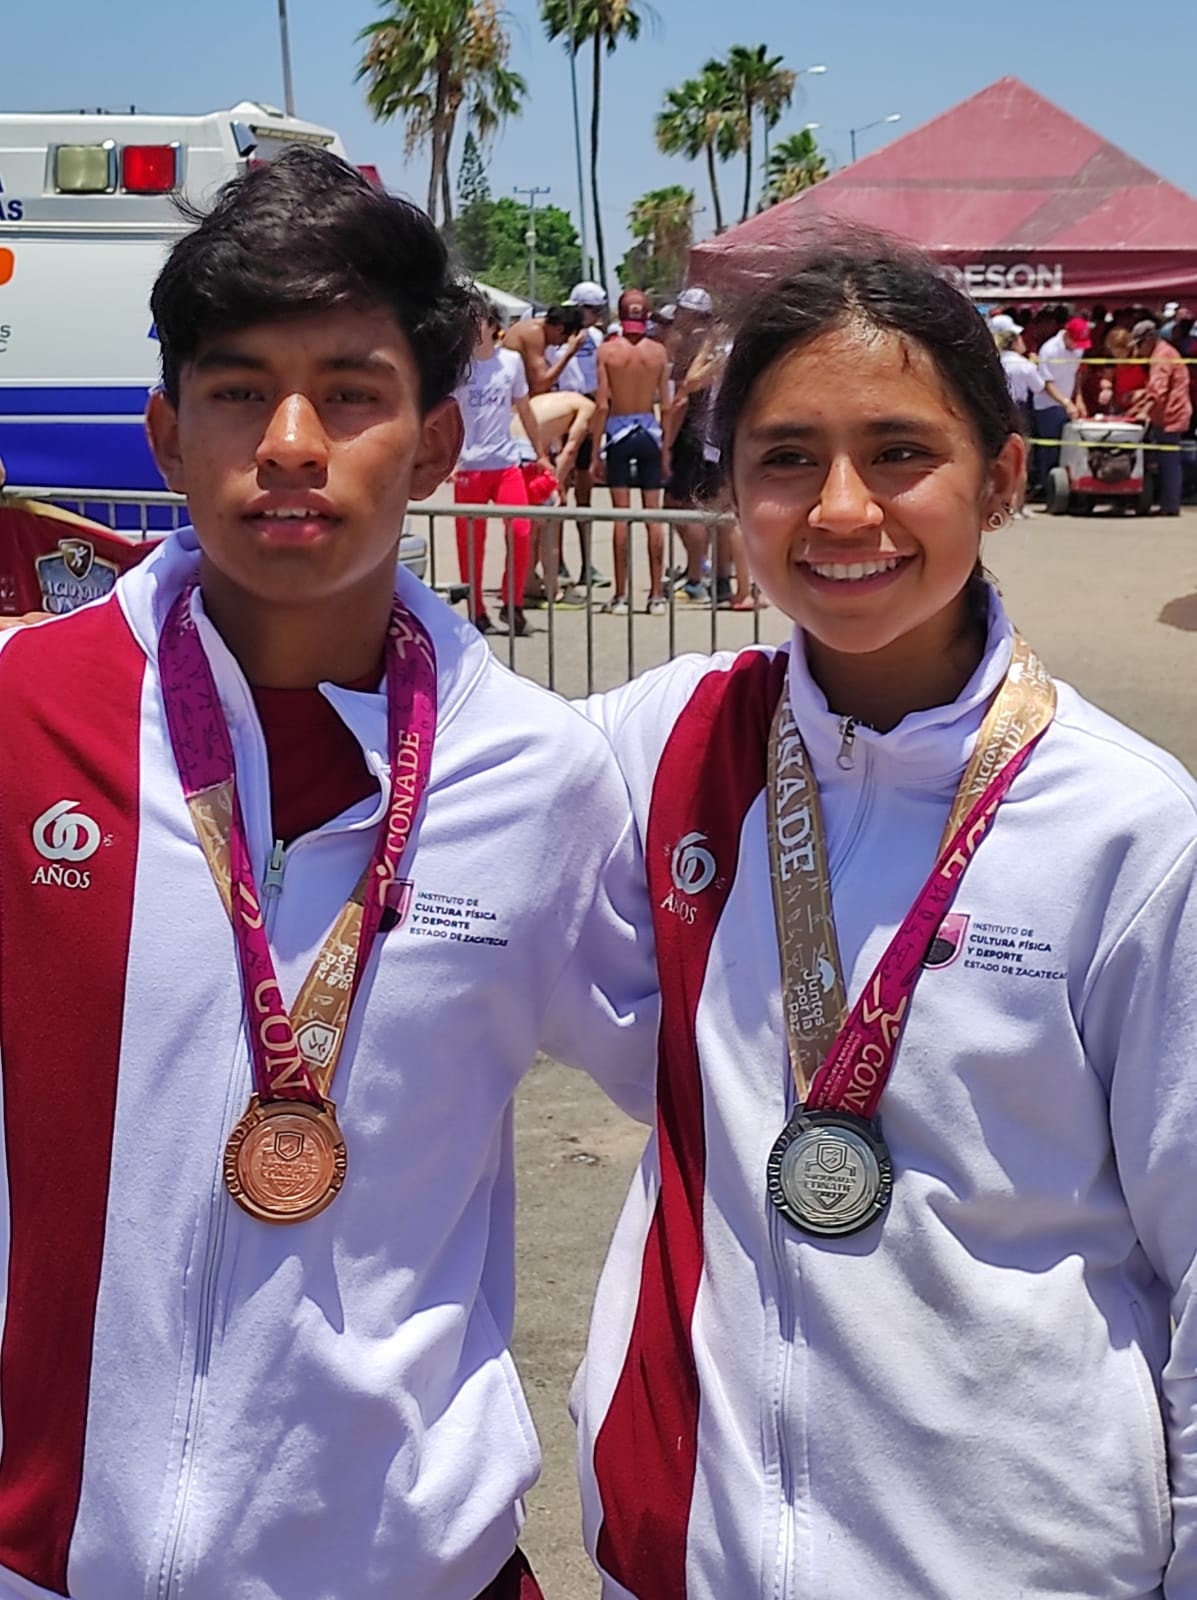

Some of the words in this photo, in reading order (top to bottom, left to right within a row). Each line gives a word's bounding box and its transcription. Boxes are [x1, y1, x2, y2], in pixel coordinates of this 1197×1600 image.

[386, 729, 420, 854] CONADE
[31, 863, 91, 889] AÑOS
[417, 891, 464, 906] INSTITUTO
[466, 898, 480, 907] DE
[414, 903, 463, 918] CULTURA
[465, 908, 497, 921] FÍSICA
[412, 914, 420, 923] Y
[421, 915, 470, 930] DEPORTE
[973, 922, 1019, 936] INSTITUTO
[1020, 928, 1034, 937] DE
[409, 927, 448, 939] ESTADO
[450, 932, 462, 942] DE
[969, 934, 1016, 949] CULTURA
[1018, 940, 1052, 953] FÍSICA
[967, 946, 975, 955] Y
[976, 948, 1023, 963] DEPORTE
[964, 960, 1000, 973] ESTADO
[1001, 966, 1013, 975] DE
[794, 984, 811, 1011] por
[803, 970, 826, 1026] Juntos
[787, 1002, 801, 1033] Paz
[801, 1014, 814, 1030] la
[254, 978, 311, 1095] CON
